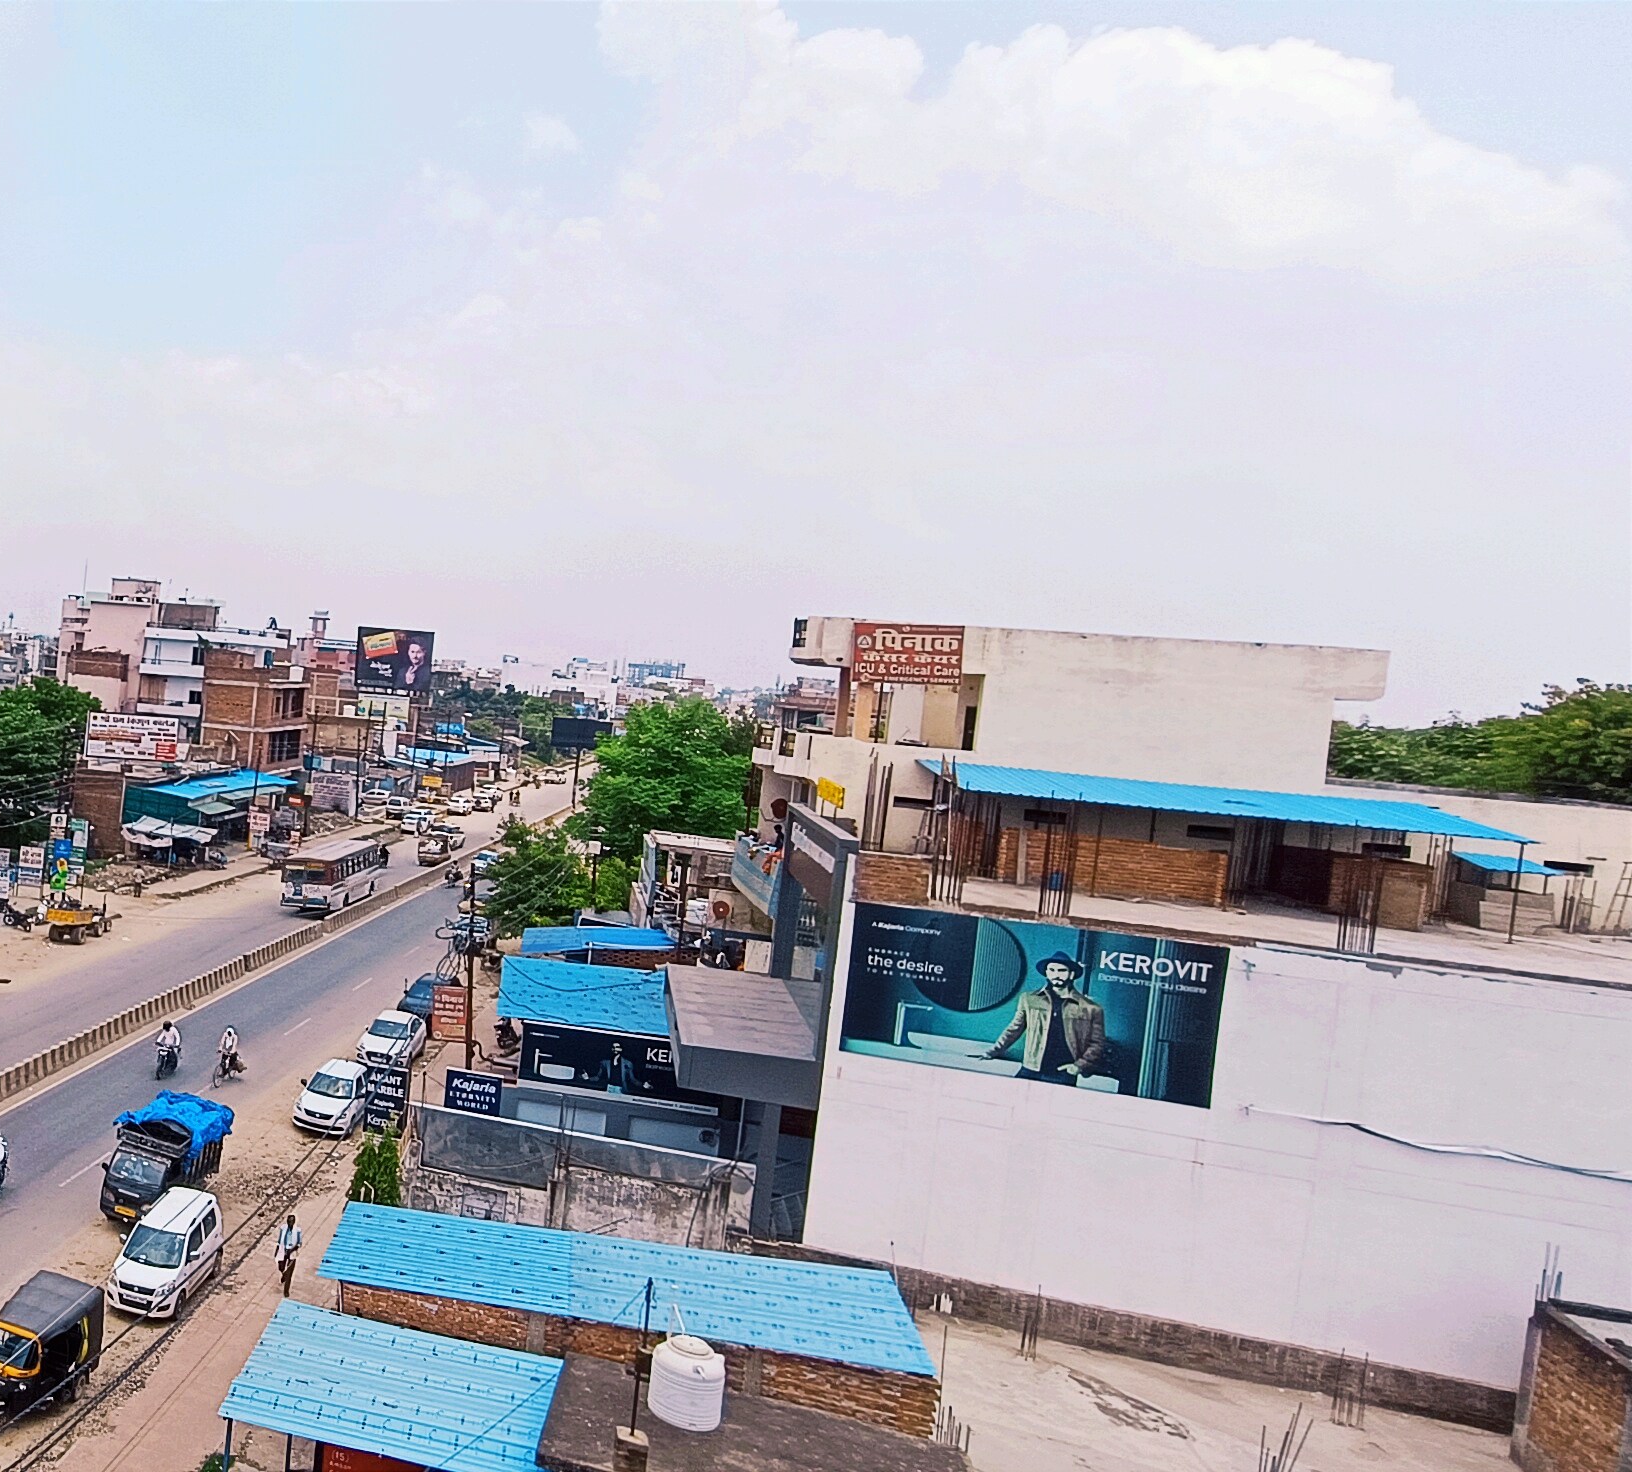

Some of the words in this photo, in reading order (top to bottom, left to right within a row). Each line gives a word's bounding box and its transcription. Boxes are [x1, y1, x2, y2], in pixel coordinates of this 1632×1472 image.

[873, 629, 962, 651] पिनाक
[855, 663, 874, 673] ICU
[878, 665, 886, 673] &
[890, 665, 930, 675] Critical
[934, 666, 960, 676] Care
[905, 925, 942, 936] Company
[868, 955, 893, 967] the
[897, 958, 944, 975] desire
[1099, 950, 1213, 982] KEROVIT
[452, 1078, 496, 1094] Kajaria
